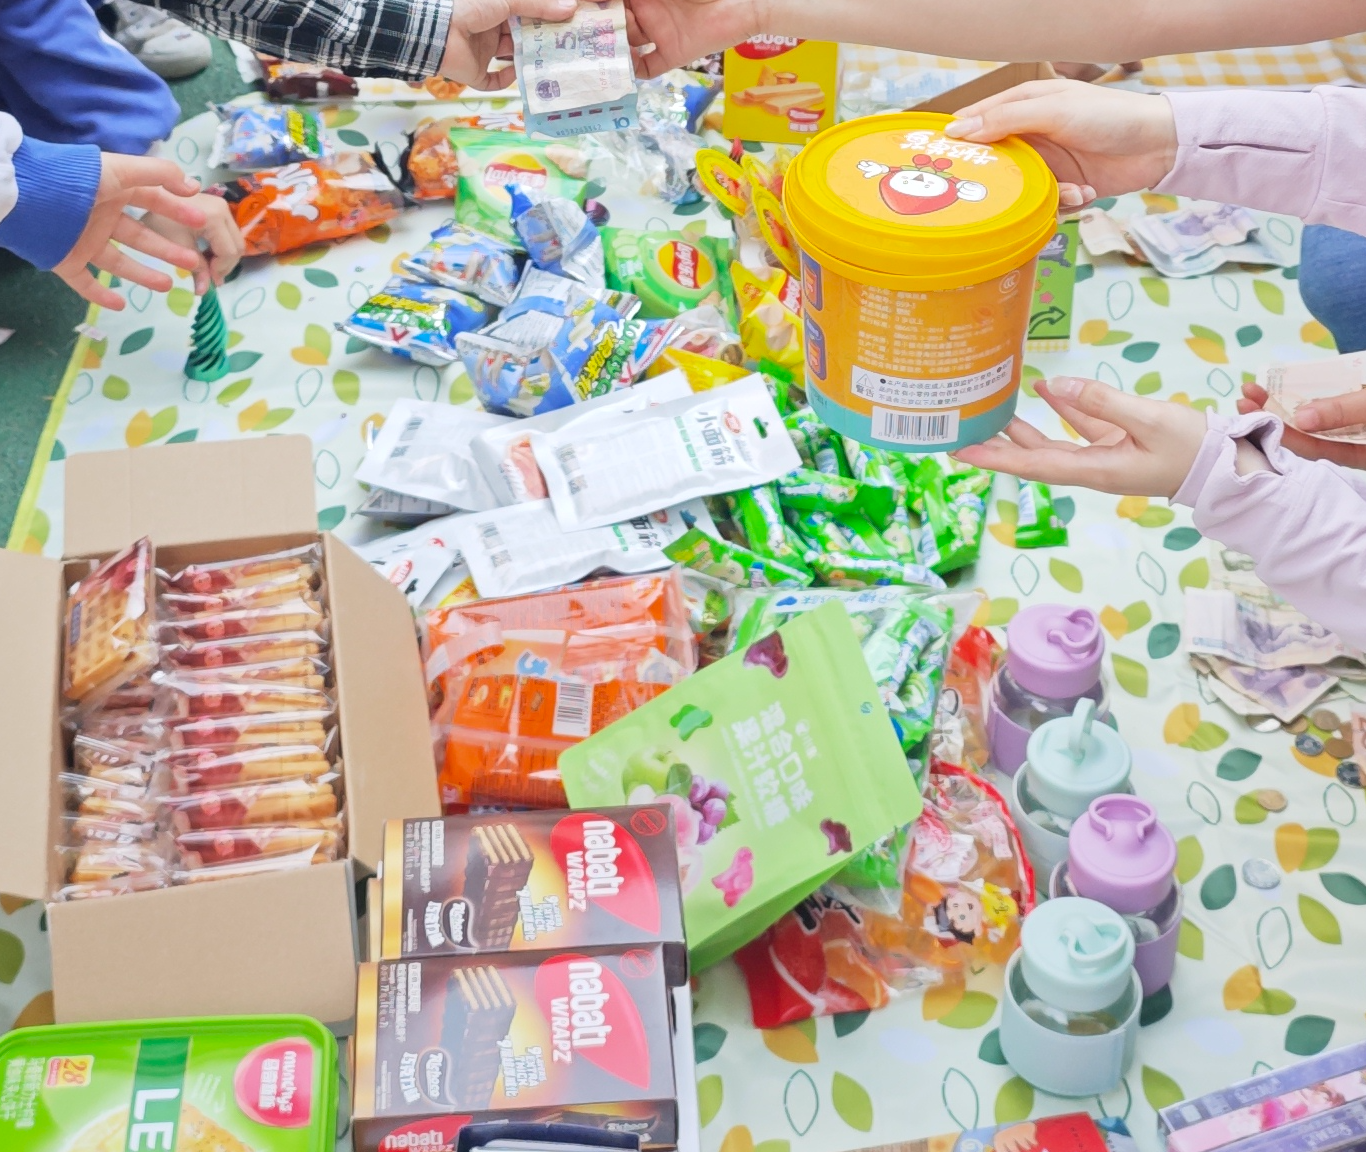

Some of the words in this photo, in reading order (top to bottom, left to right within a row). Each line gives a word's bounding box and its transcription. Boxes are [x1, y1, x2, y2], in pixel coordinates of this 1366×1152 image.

[759, 700, 814, 813] 混合口味
[566, 850, 587, 913] WRAPZ
[582, 820, 625, 898] nabati
[550, 997, 573, 1064] WRAPZ
[568, 961, 612, 1048] nabati
[61, 1057, 87, 1086] 28
[385, 1130, 443, 1149] nabati
